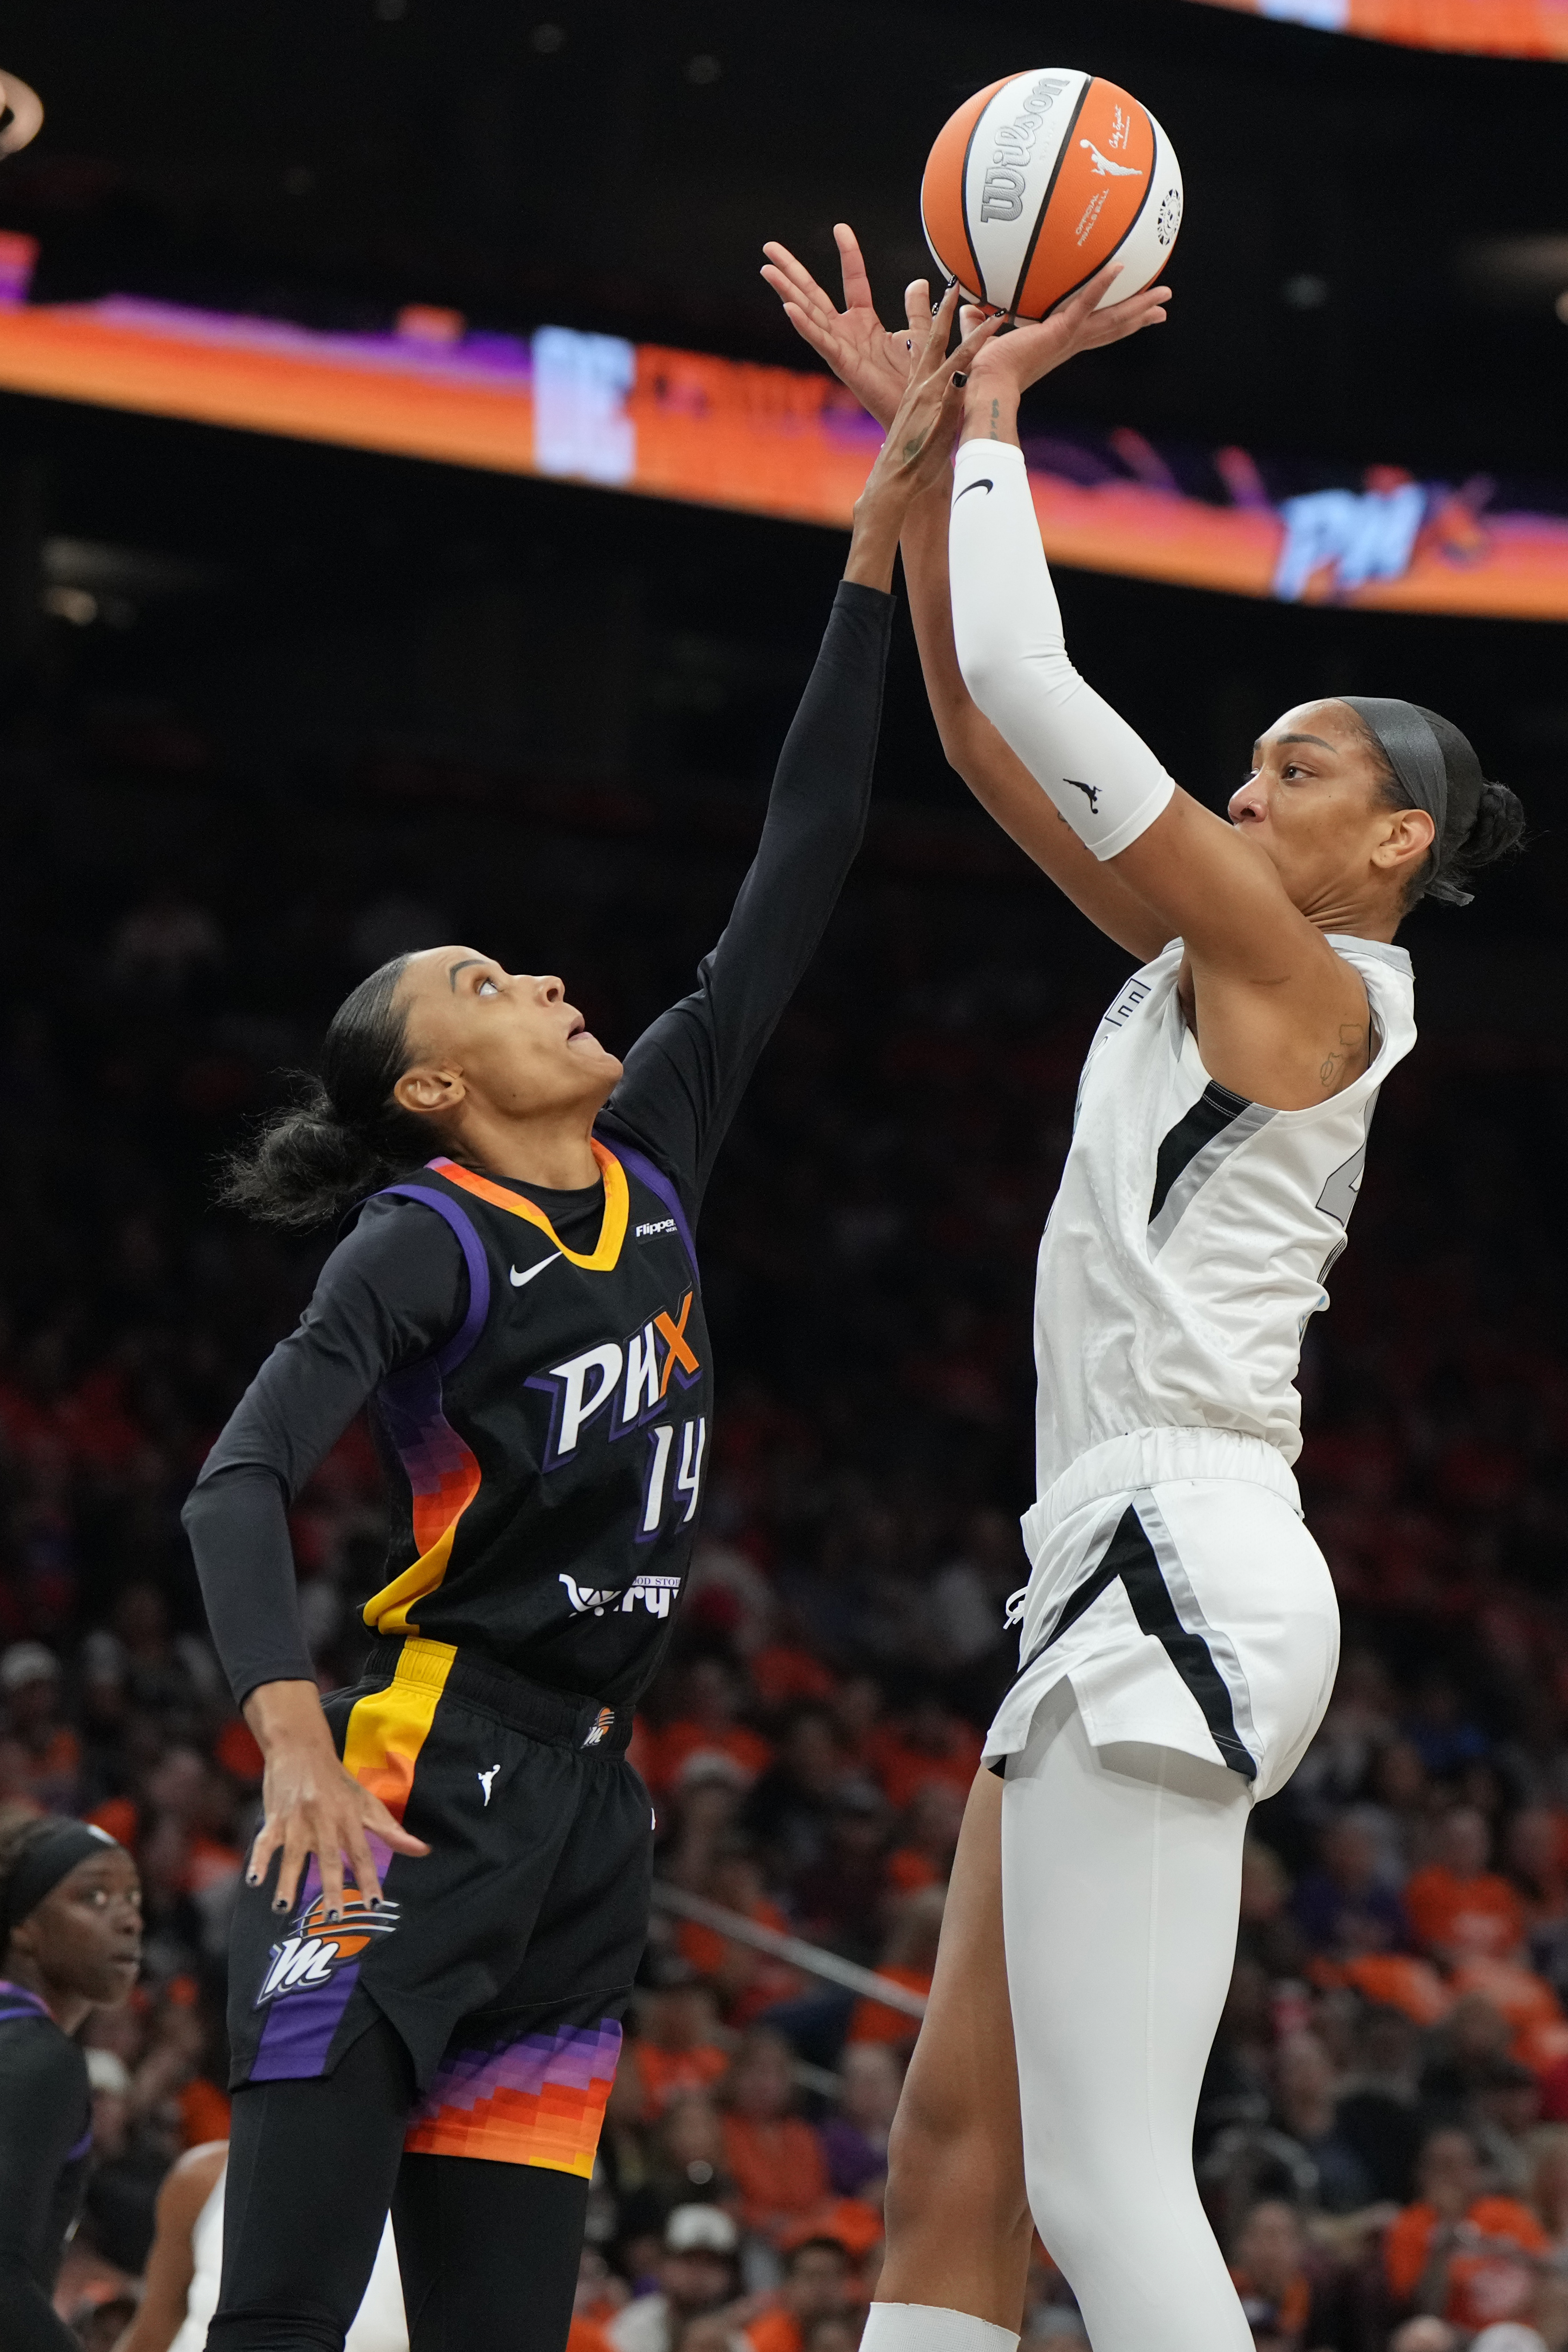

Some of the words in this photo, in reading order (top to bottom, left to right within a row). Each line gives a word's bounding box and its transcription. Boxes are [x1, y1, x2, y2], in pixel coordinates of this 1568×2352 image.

[981, 77, 1070, 223] Wilson
[1095, 188, 1110, 213] BALL
[1075, 193, 1099, 235] OFFICIAL
[549, 1291, 700, 1455] PHX
[643, 1417, 706, 1532] 14
